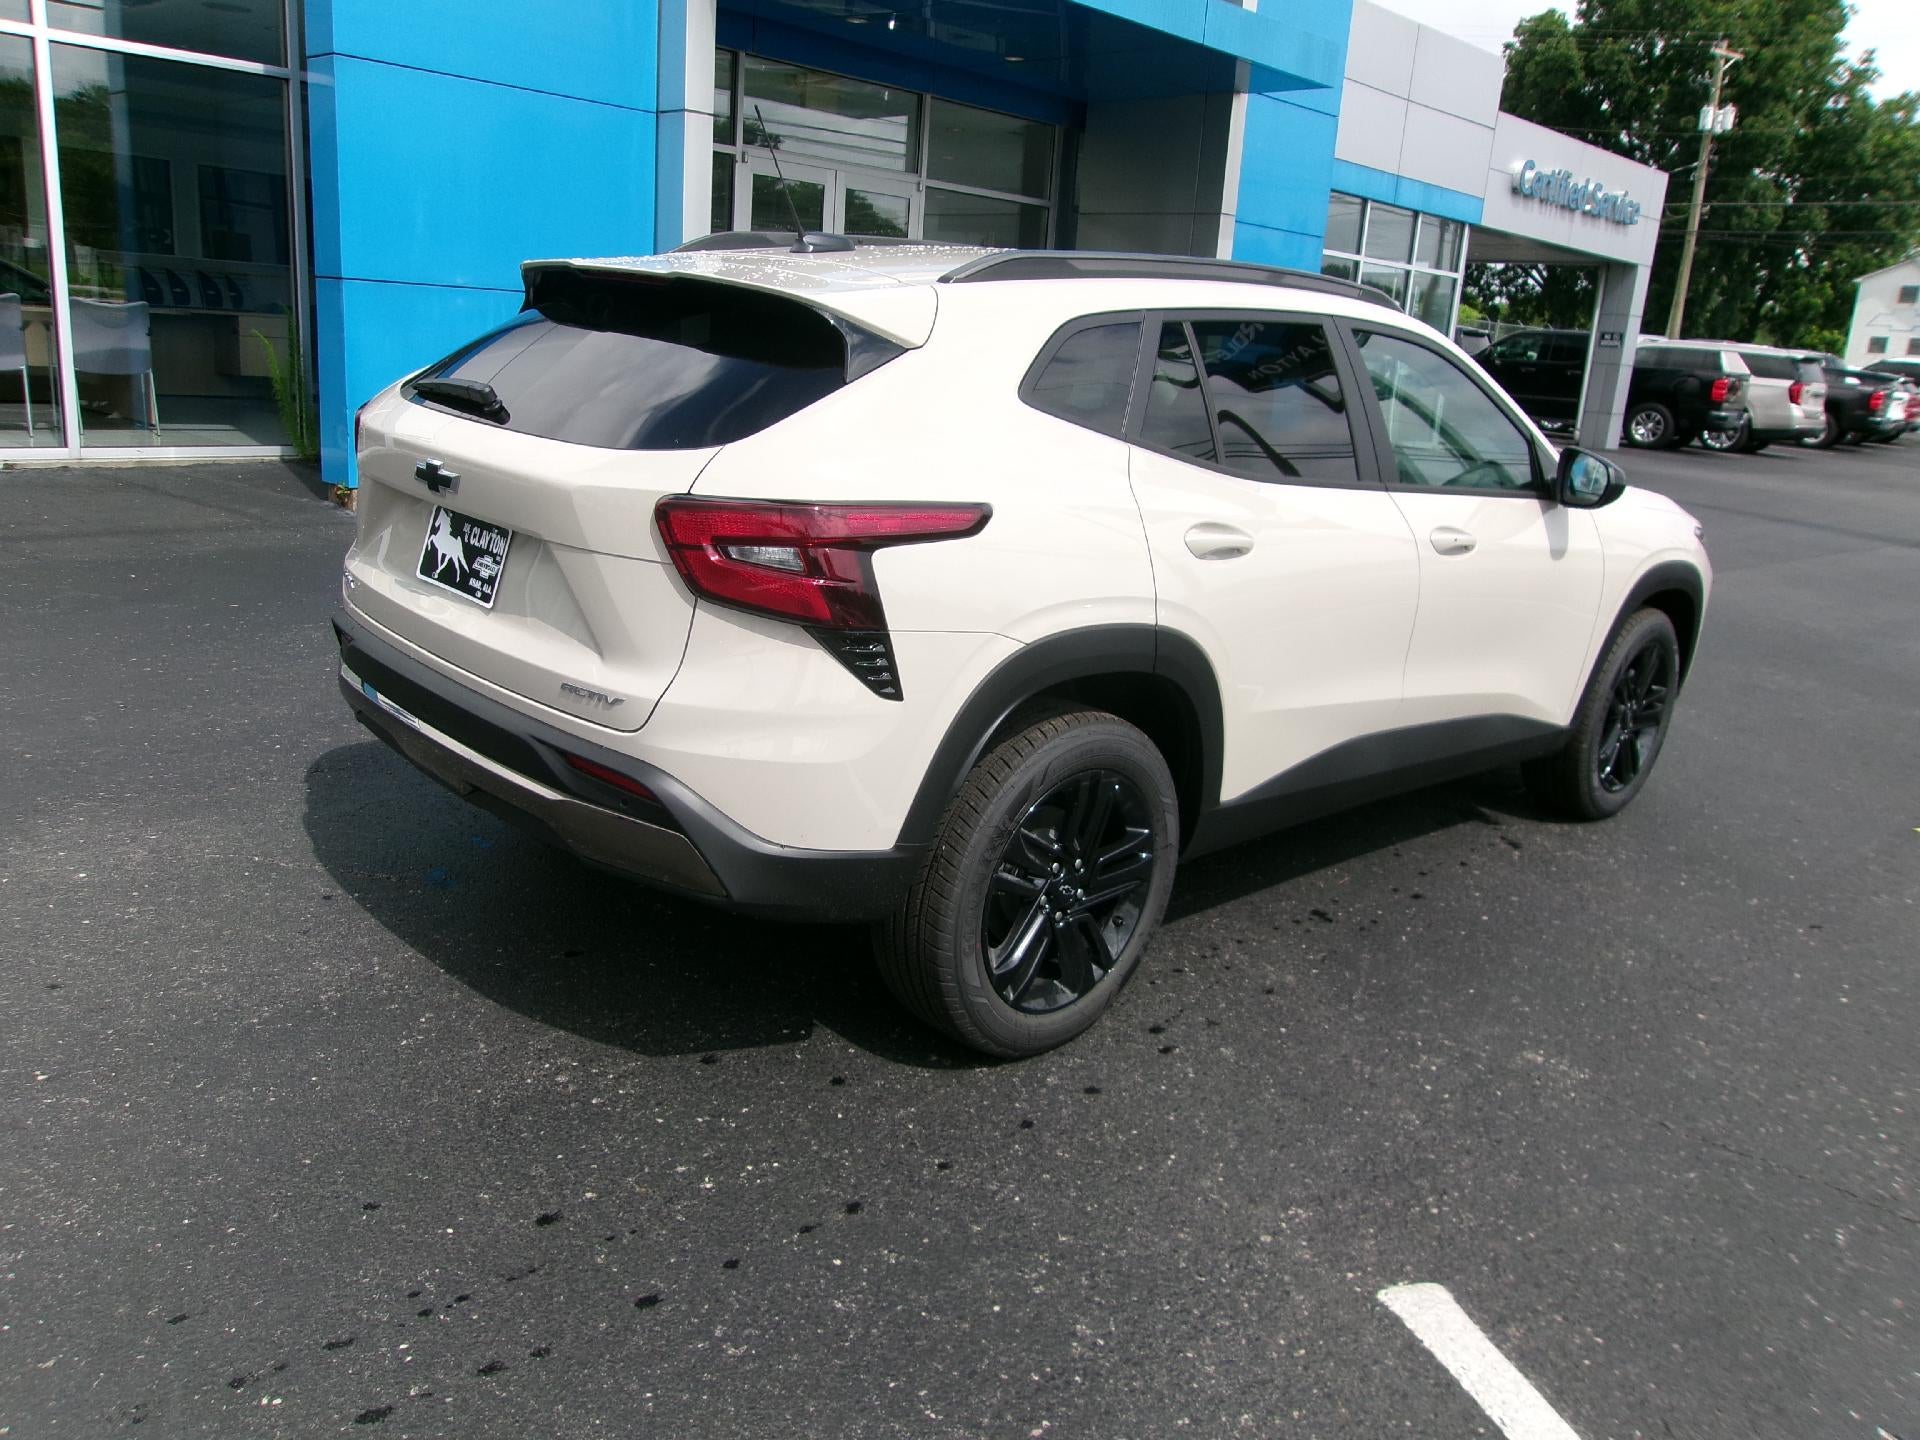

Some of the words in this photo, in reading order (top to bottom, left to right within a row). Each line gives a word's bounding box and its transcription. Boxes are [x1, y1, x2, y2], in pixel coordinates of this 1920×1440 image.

[1520, 159, 1590, 211] Certified
[1591, 182, 1641, 225] Service
[470, 526, 507, 556] CLAYTON
[560, 682, 626, 705] ACTIV
